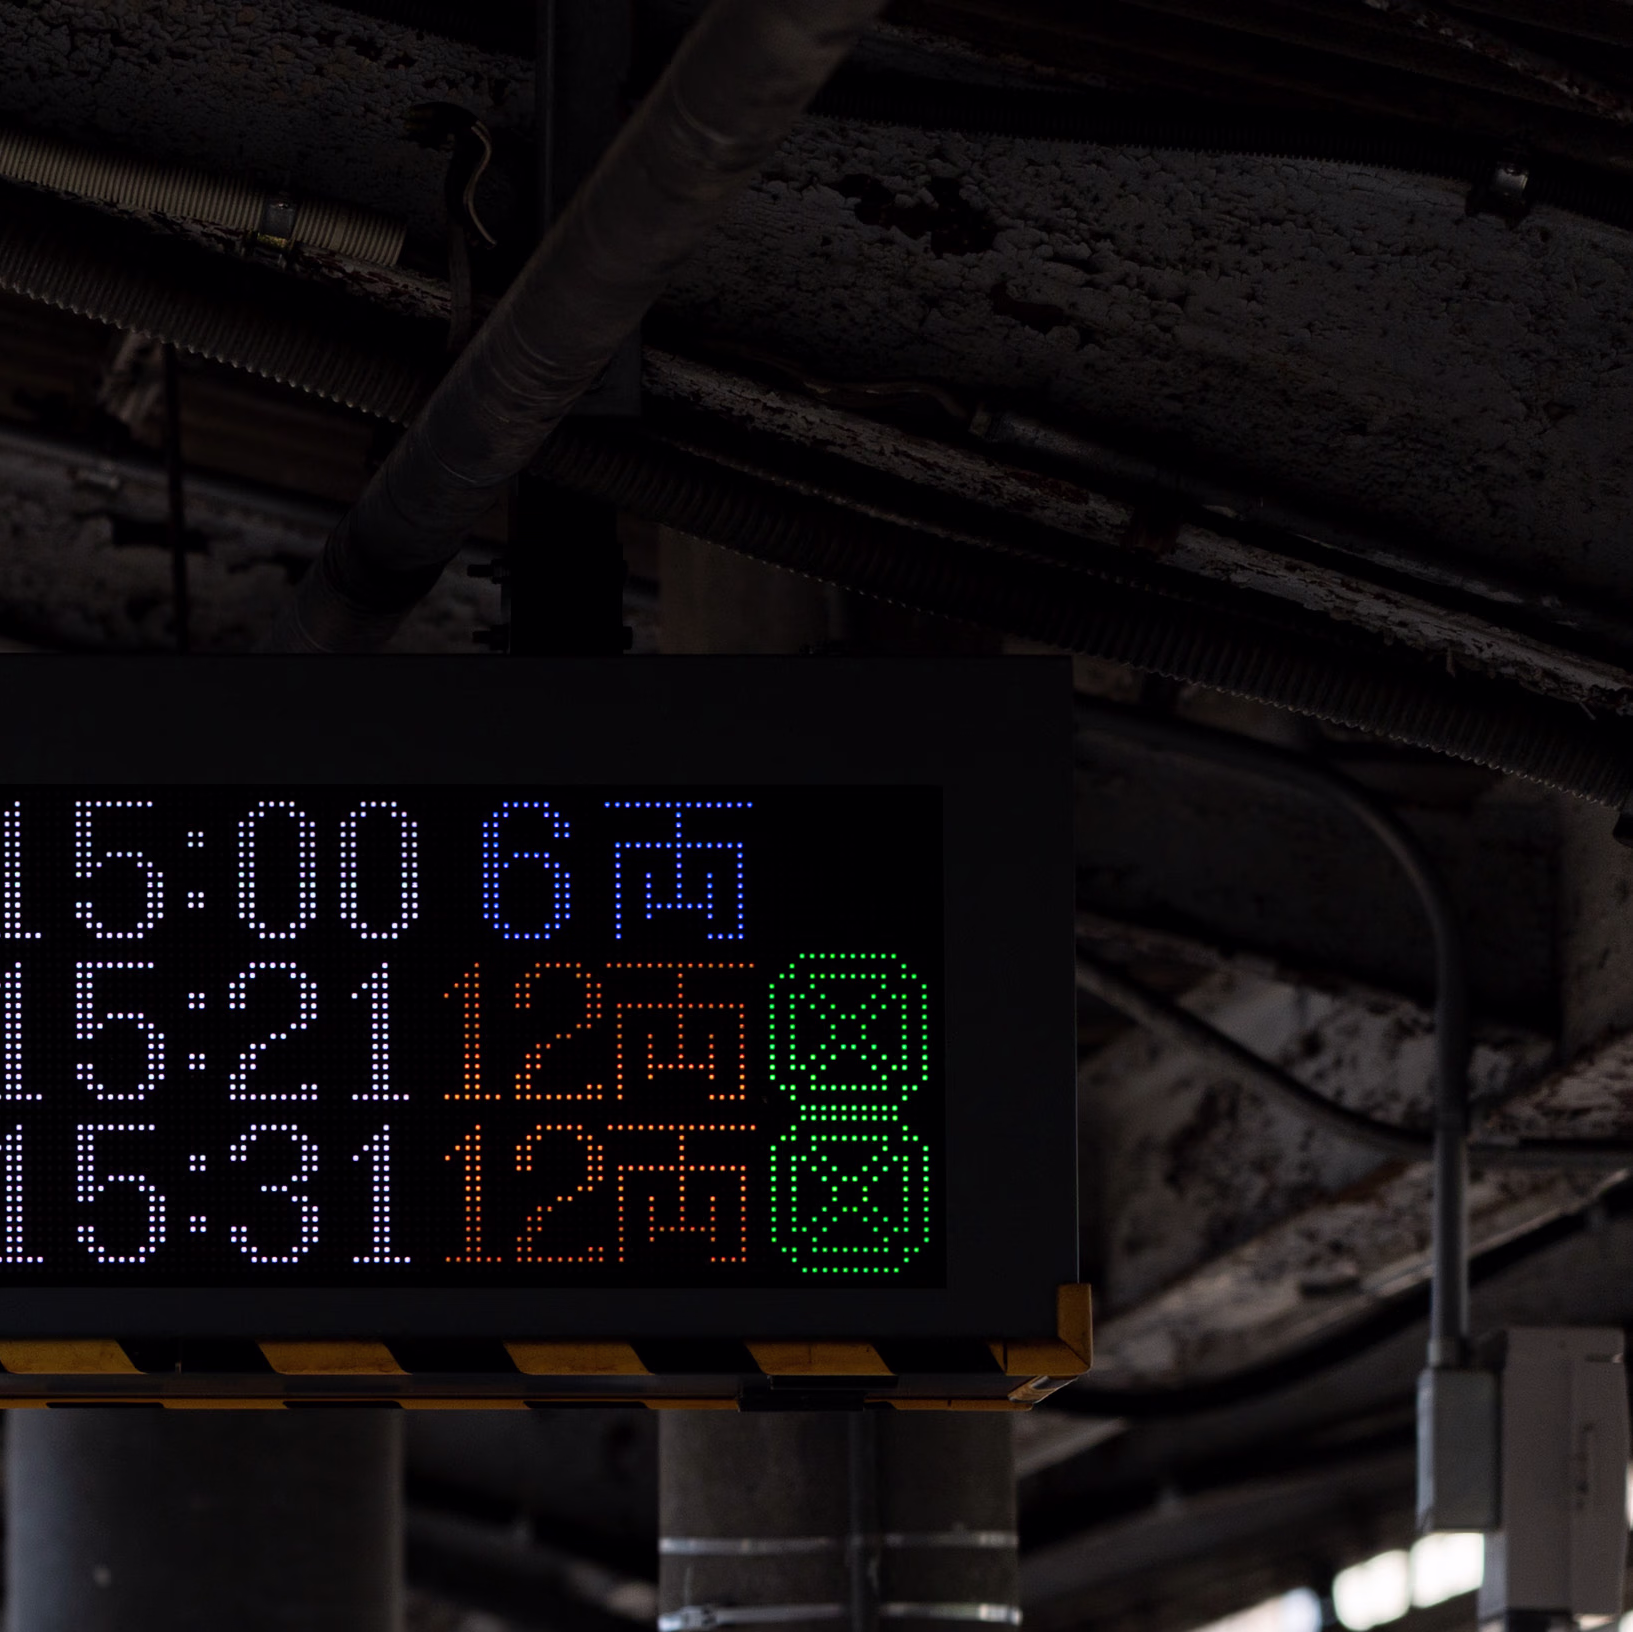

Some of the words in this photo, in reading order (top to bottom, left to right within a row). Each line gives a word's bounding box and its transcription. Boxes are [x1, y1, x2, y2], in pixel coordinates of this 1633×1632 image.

[482, 801, 754, 940] 6両
[443, 961, 755, 1101] 12両
[444, 1124, 757, 1263] 12両
